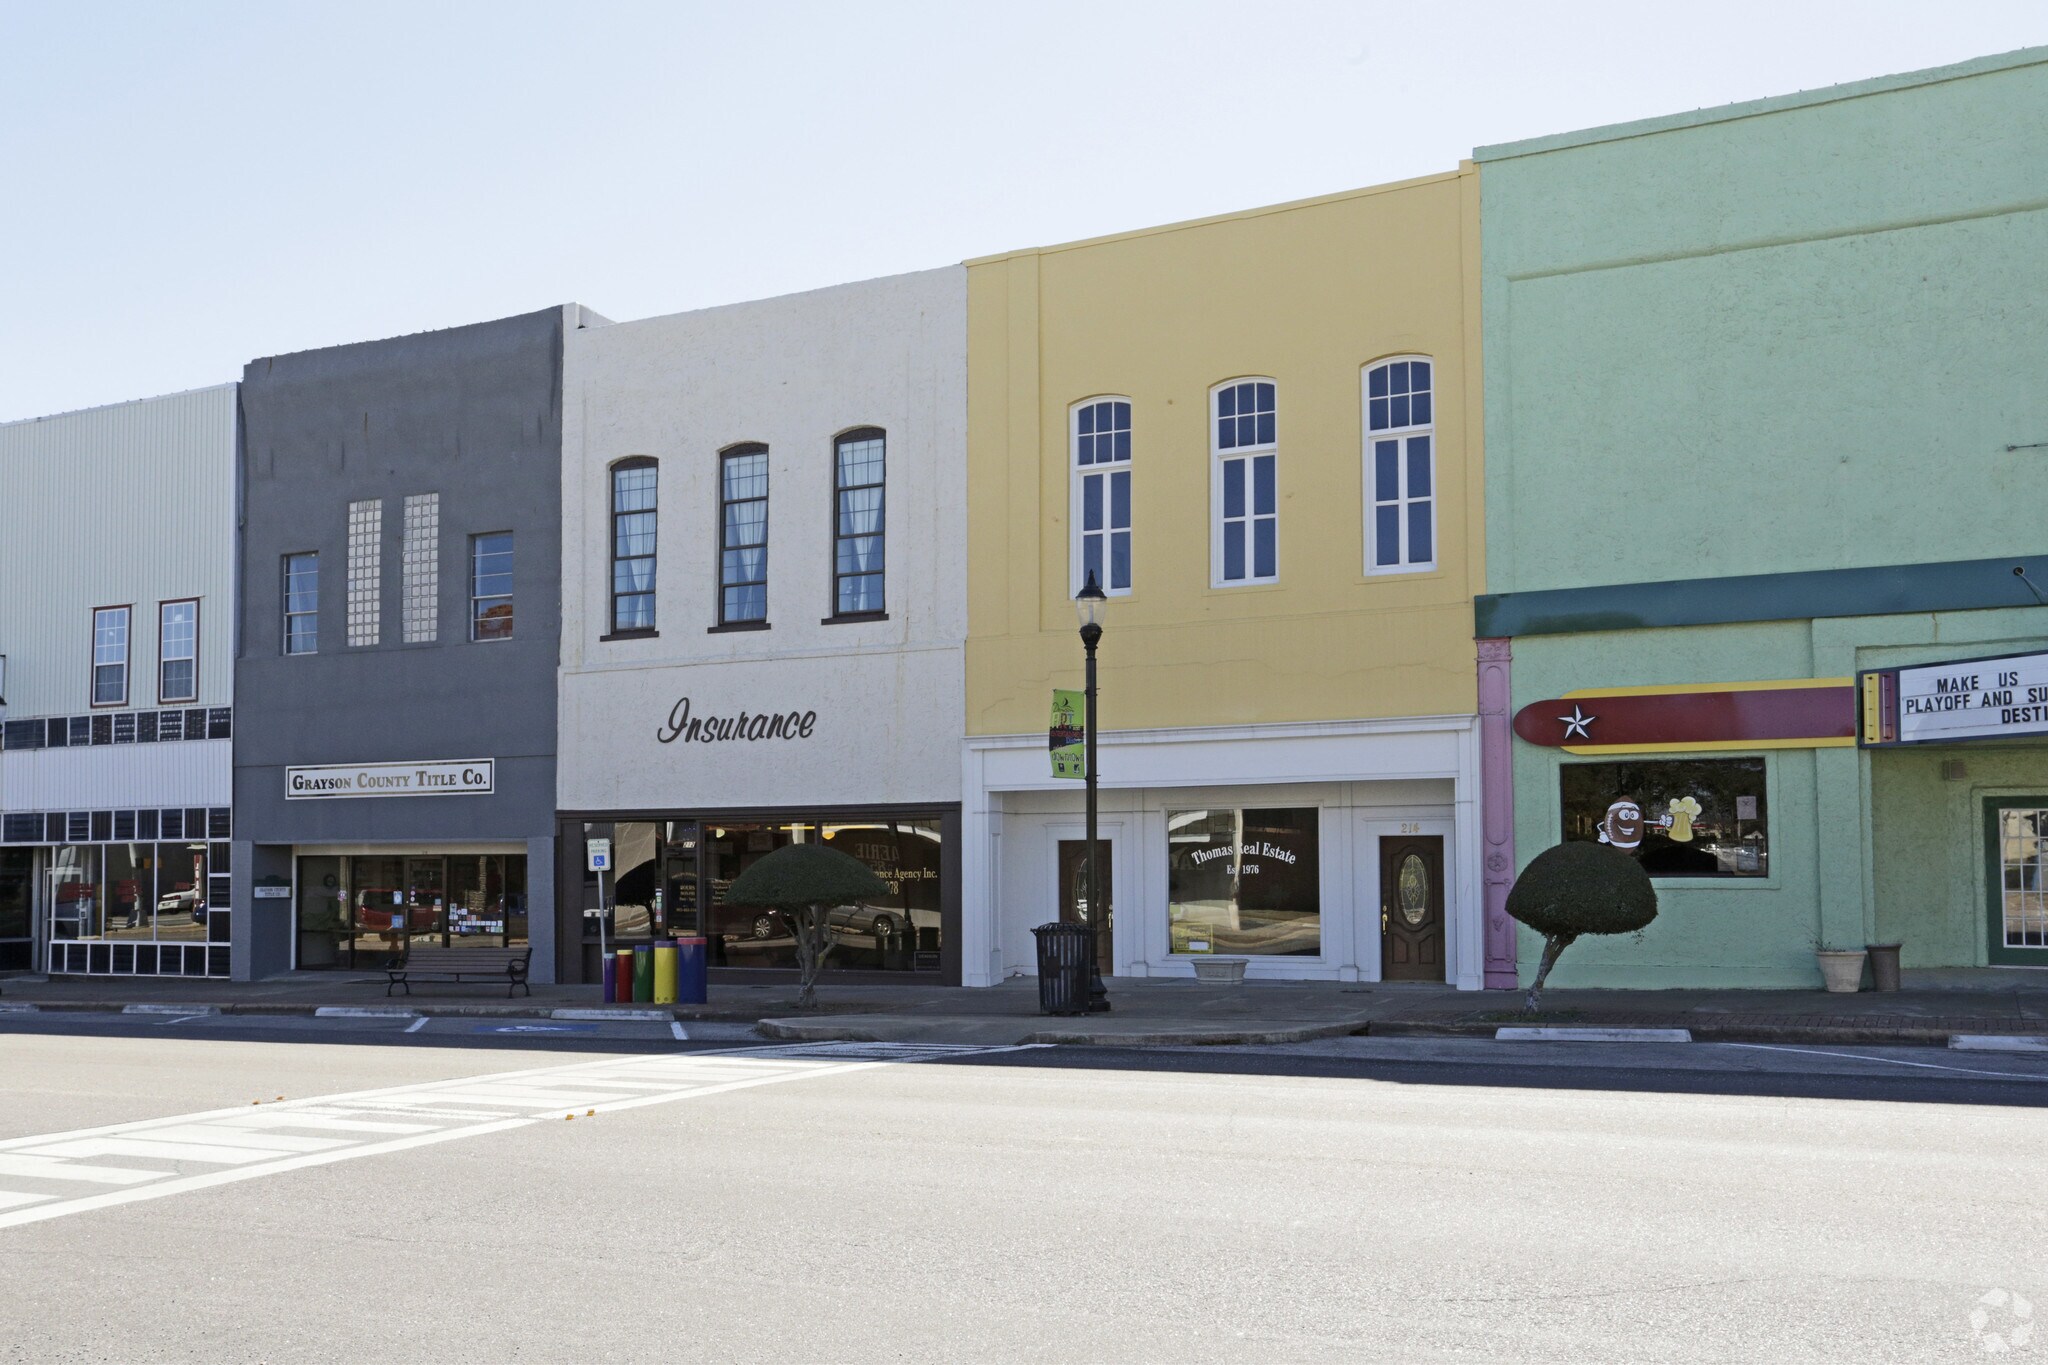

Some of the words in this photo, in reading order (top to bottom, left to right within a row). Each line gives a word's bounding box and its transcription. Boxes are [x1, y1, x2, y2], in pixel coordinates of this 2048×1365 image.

[1937, 675, 1979, 694] MAKE
[1998, 671, 2018, 687] US
[1906, 694, 1971, 713] PLAYOFF
[1981, 690, 2013, 707] AND
[657, 697, 817, 743] Insurance
[292, 775, 351, 790] GRAYSON
[357, 773, 410, 788] COUNTY
[416, 770, 457, 786] TITLE
[1191, 845, 1233, 865] Thomas
[1262, 842, 1296, 864] Estate
[894, 868, 921, 882] Agency
[923, 867, 938, 879] Inc.
[1226, 864, 1238, 875] Es
[1242, 864, 1260, 875] 1976
